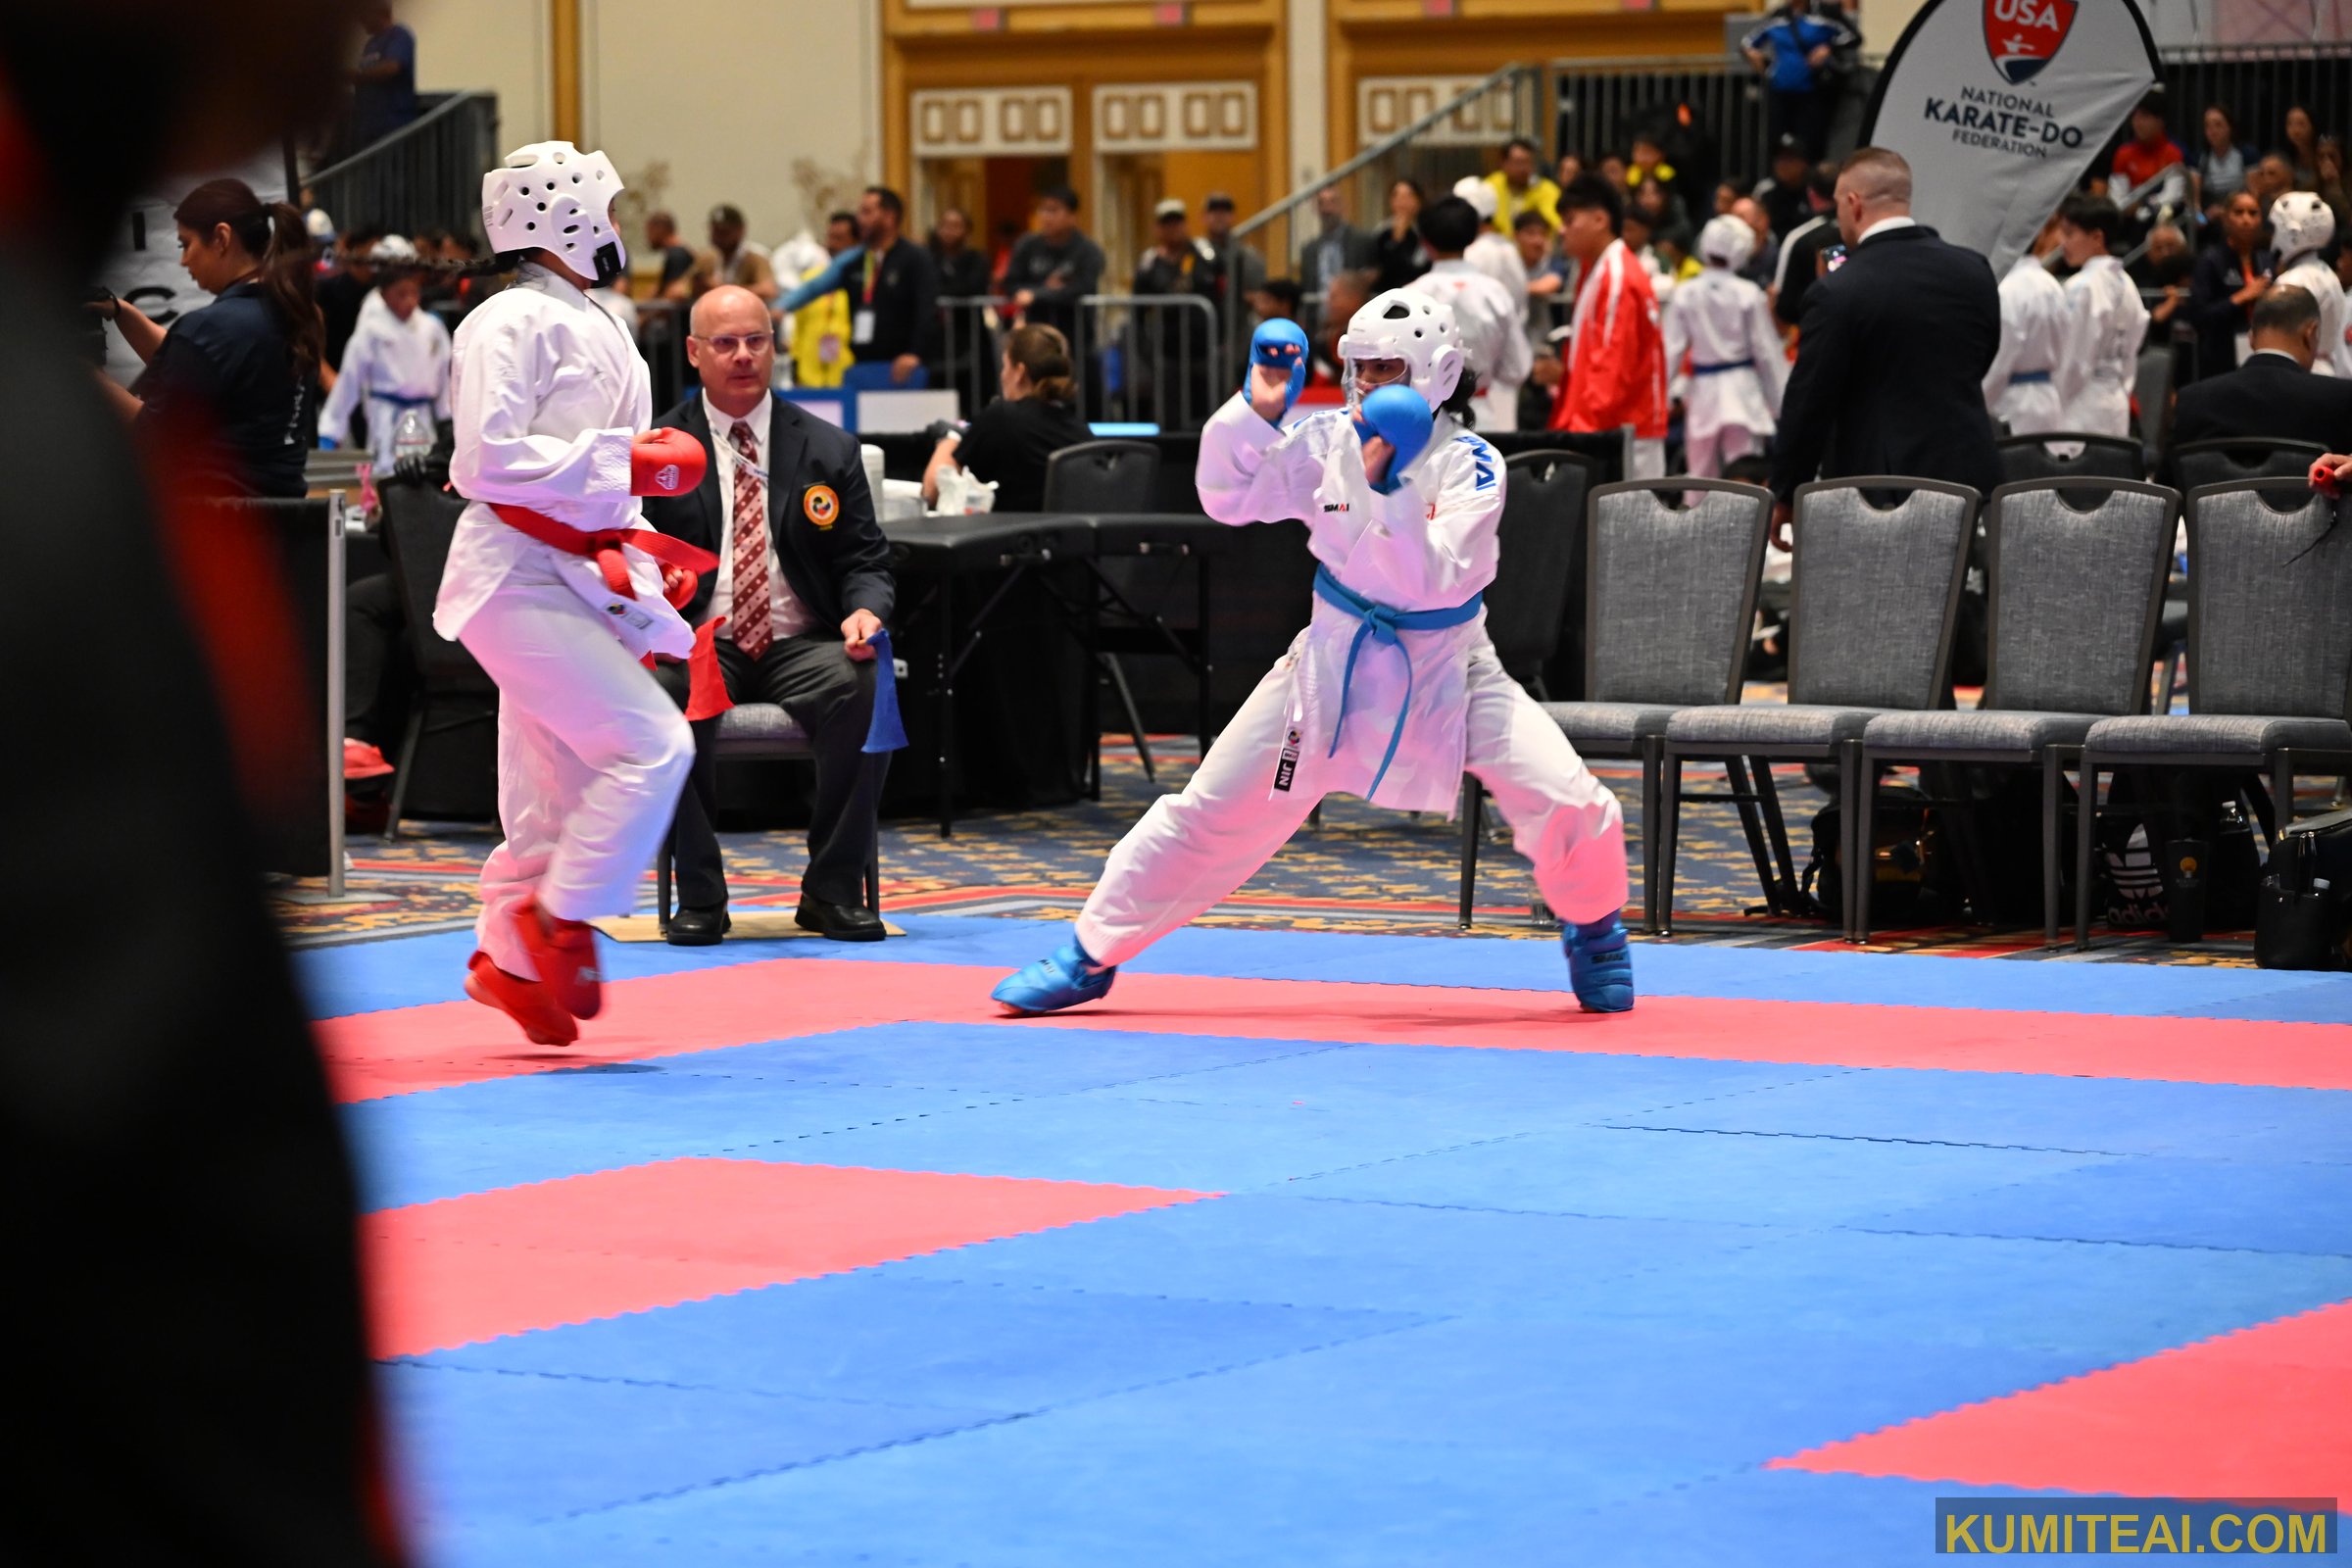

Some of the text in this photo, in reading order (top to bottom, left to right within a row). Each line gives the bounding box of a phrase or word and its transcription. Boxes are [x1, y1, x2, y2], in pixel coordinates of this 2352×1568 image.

[1994, 0, 2059, 32] USA
[1961, 85, 2054, 119] NATIONAL
[1924, 97, 2083, 149] KARATE-DO
[1952, 127, 2047, 159] FEDERATION
[1278, 762, 1293, 787] JIN
[2108, 901, 2172, 924] adid
